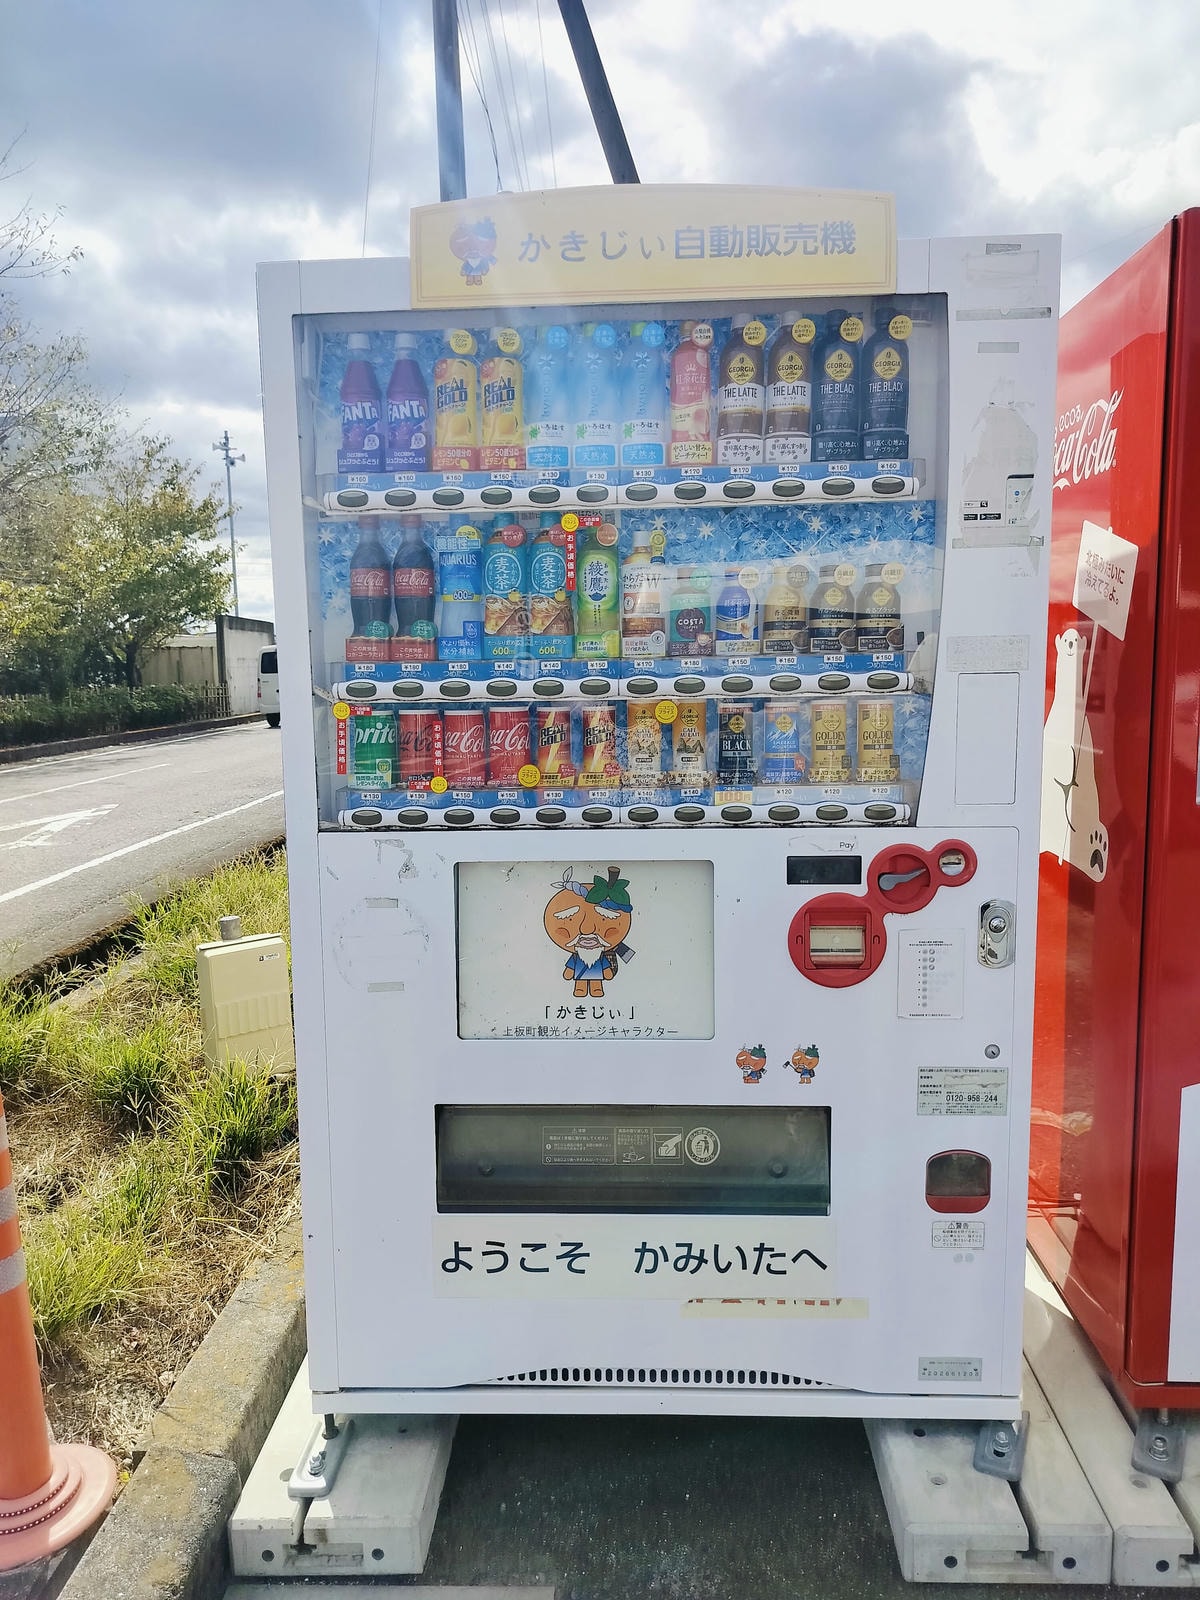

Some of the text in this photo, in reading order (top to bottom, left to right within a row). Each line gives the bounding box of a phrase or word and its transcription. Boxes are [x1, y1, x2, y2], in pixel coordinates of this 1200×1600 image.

[724, 387, 757, 398] THE LATTE
[773, 385, 806, 397] THE LATTE
[820, 382, 855, 394] THE BLACK
[869, 381, 904, 393] THE BLACK
[494, 557, 511, 590] 麦茶
[541, 556, 558, 588] 麦茶
[1085, 550, 1126, 585] 北極みたいに
[588, 560, 604, 592] 綾鷹
[1084, 570, 1120, 606] 冷えてるよ。
[678, 618, 704, 626] COSTA
[540, 723, 567, 738] REAL
[585, 724, 612, 738] REAL
[540, 732, 566, 747] GOLD
[585, 732, 612, 747] GOLD
[722, 740, 752, 751] BLACK
[839, 841, 855, 851] Pay
[545, 1005, 635, 1020] 「かきじぃ」
[503, 1025, 678, 1037] 上板町観光イメージキャラクター
[946, 1094, 998, 1102] 0120-958-244
[441, 1240, 828, 1275] ようこそ かみいたへ
